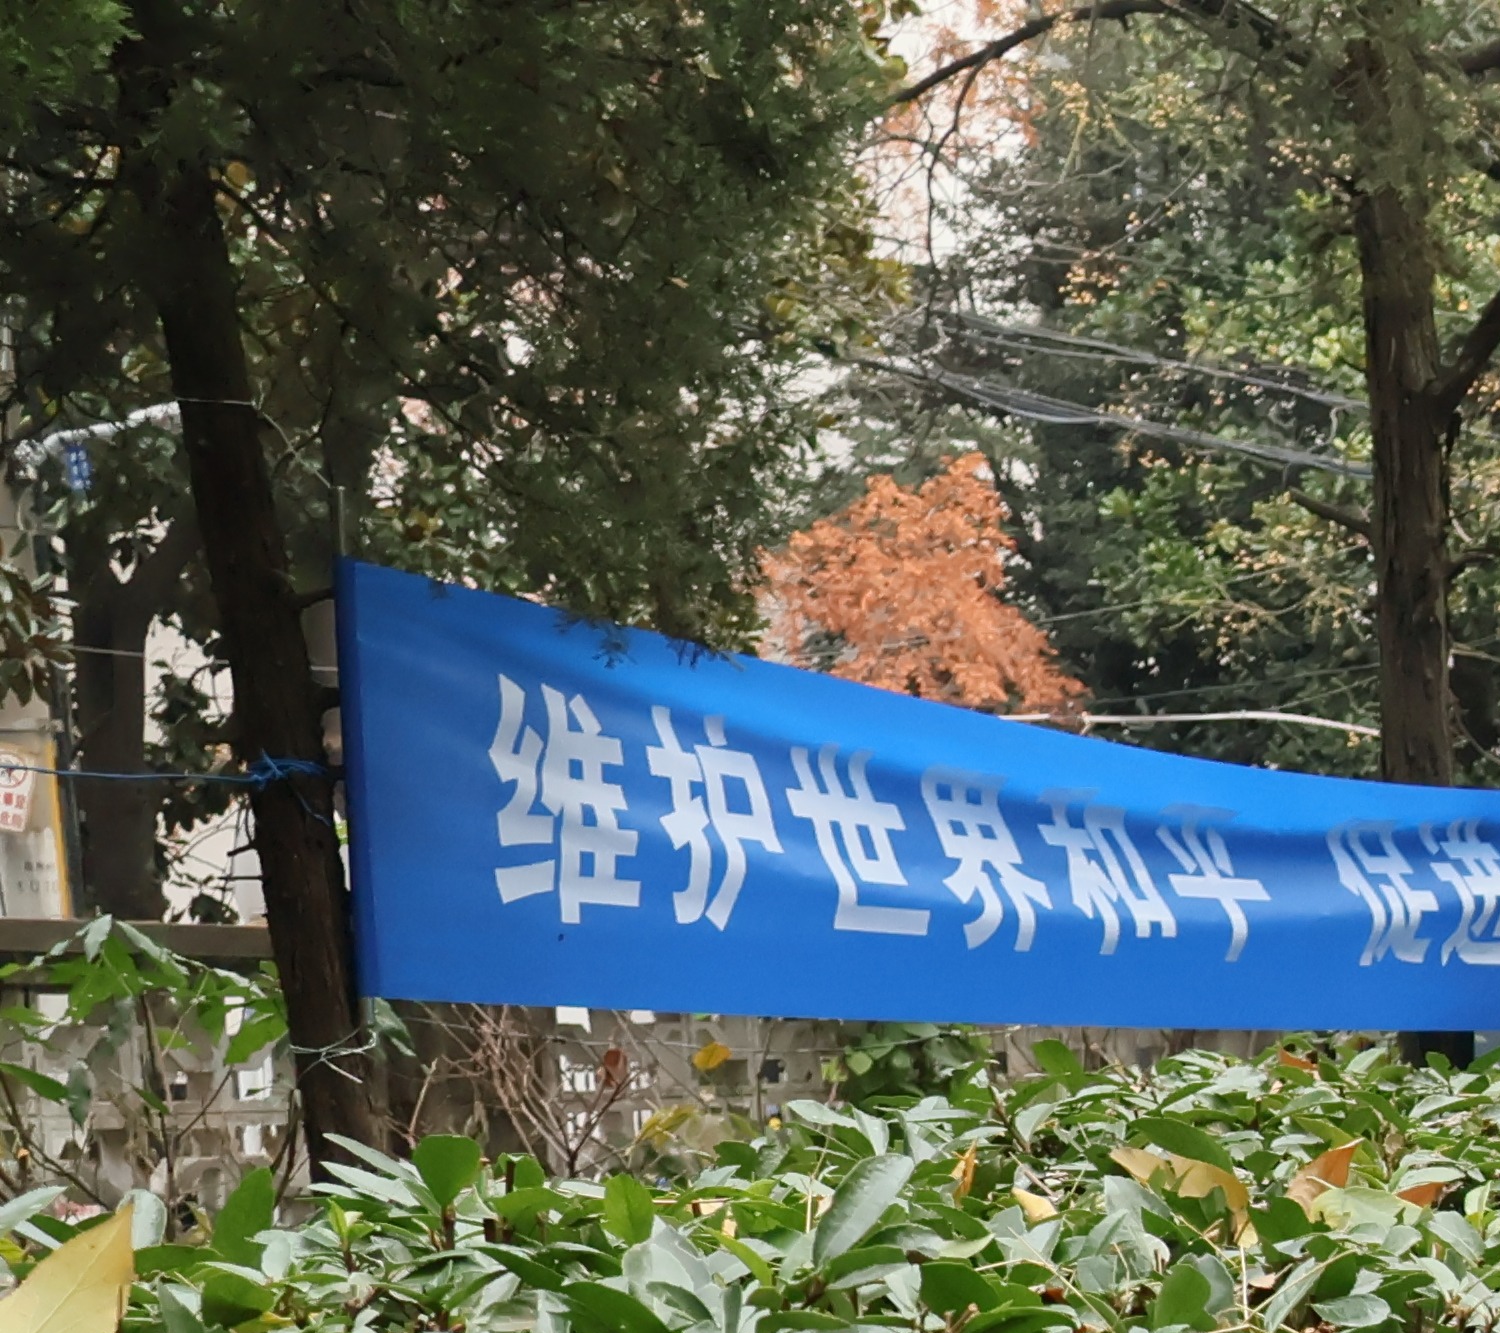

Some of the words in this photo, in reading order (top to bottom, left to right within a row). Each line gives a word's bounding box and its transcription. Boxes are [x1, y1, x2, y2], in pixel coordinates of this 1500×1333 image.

[488, 673, 1272, 963] 维护世界和平
